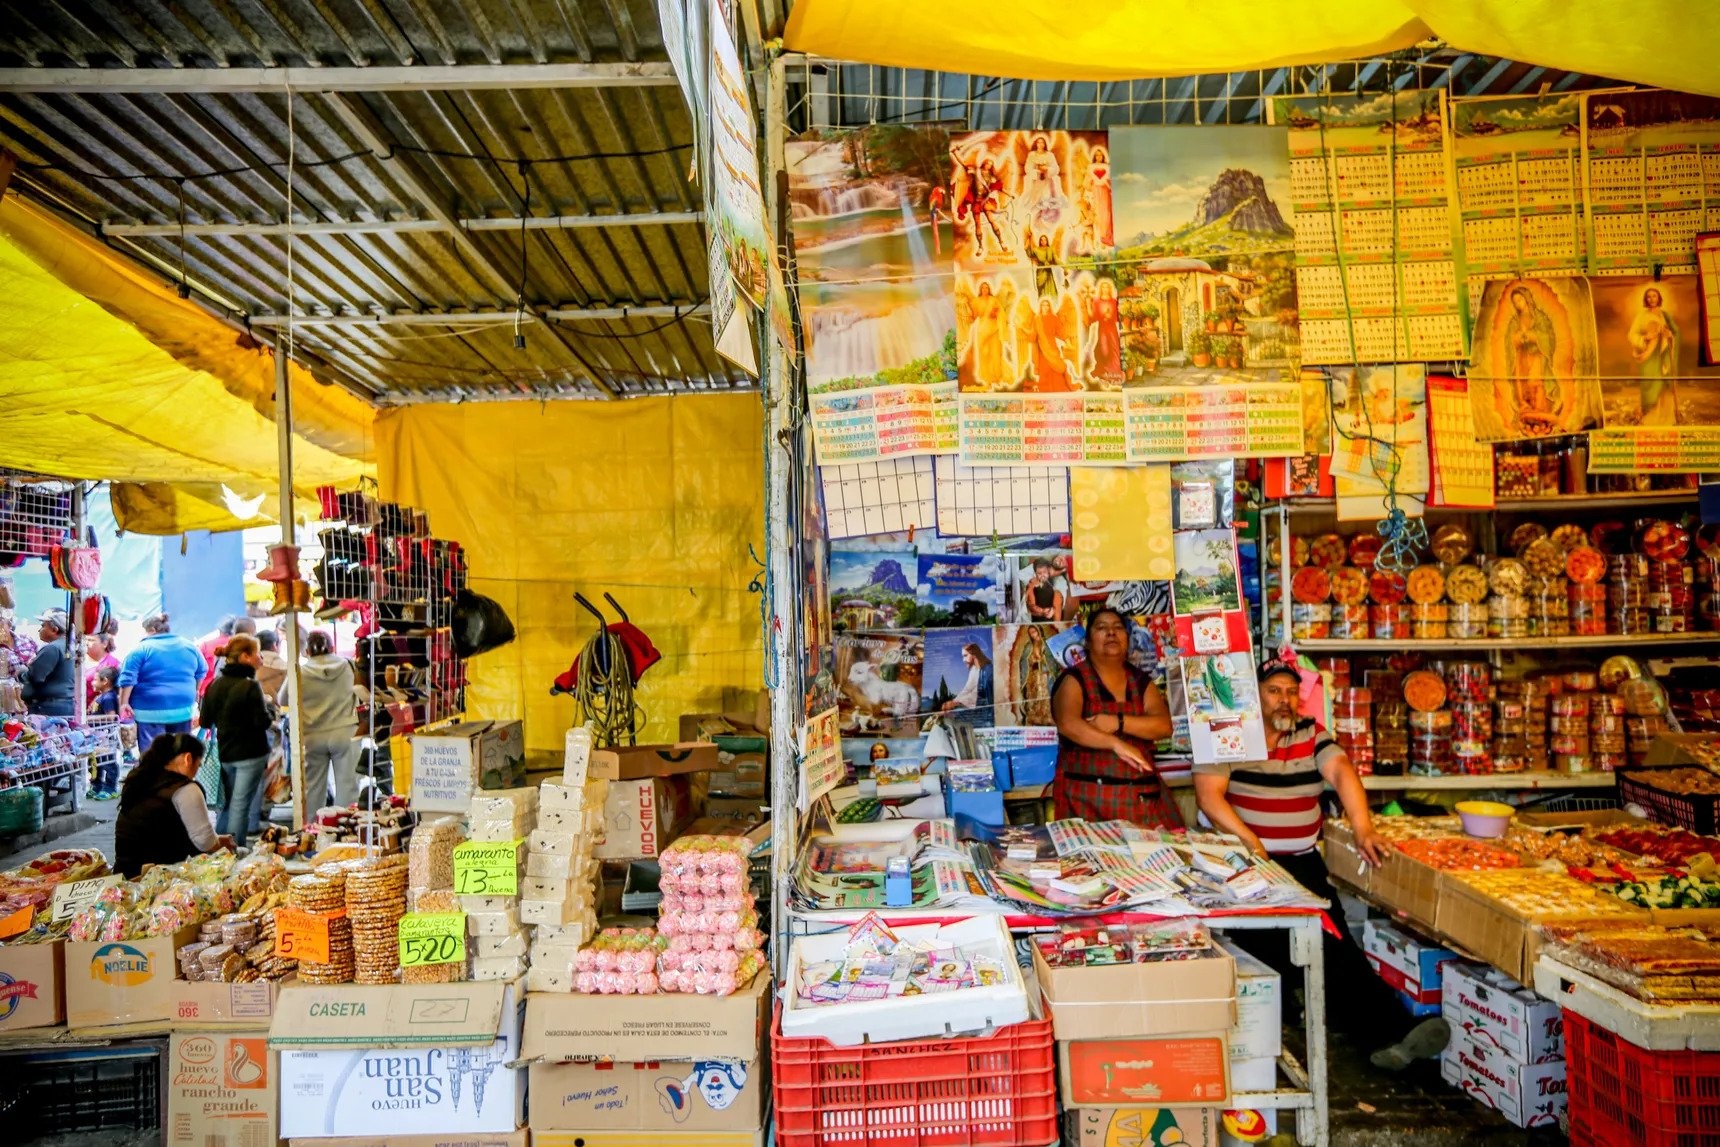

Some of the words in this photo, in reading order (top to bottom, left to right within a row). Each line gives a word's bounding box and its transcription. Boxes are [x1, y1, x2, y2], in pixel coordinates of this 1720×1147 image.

[639, 786, 655, 855] HUEVOS
[455, 848, 515, 860] amaranto
[280, 933, 294, 953] 5
[104, 960, 149, 974] NOELIE
[309, 1002, 367, 1017] CASETA
[1458, 992, 1508, 1026] Tomatoes
[186, 1044, 212, 1052] 360
[180, 1062, 219, 1073] huevo
[365, 1049, 442, 1078] Juan
[1458, 1051, 1506, 1088] Tomatoes
[182, 1085, 237, 1098] rancho
[386, 1076, 443, 1104] San
[202, 1098, 258, 1114] grande
